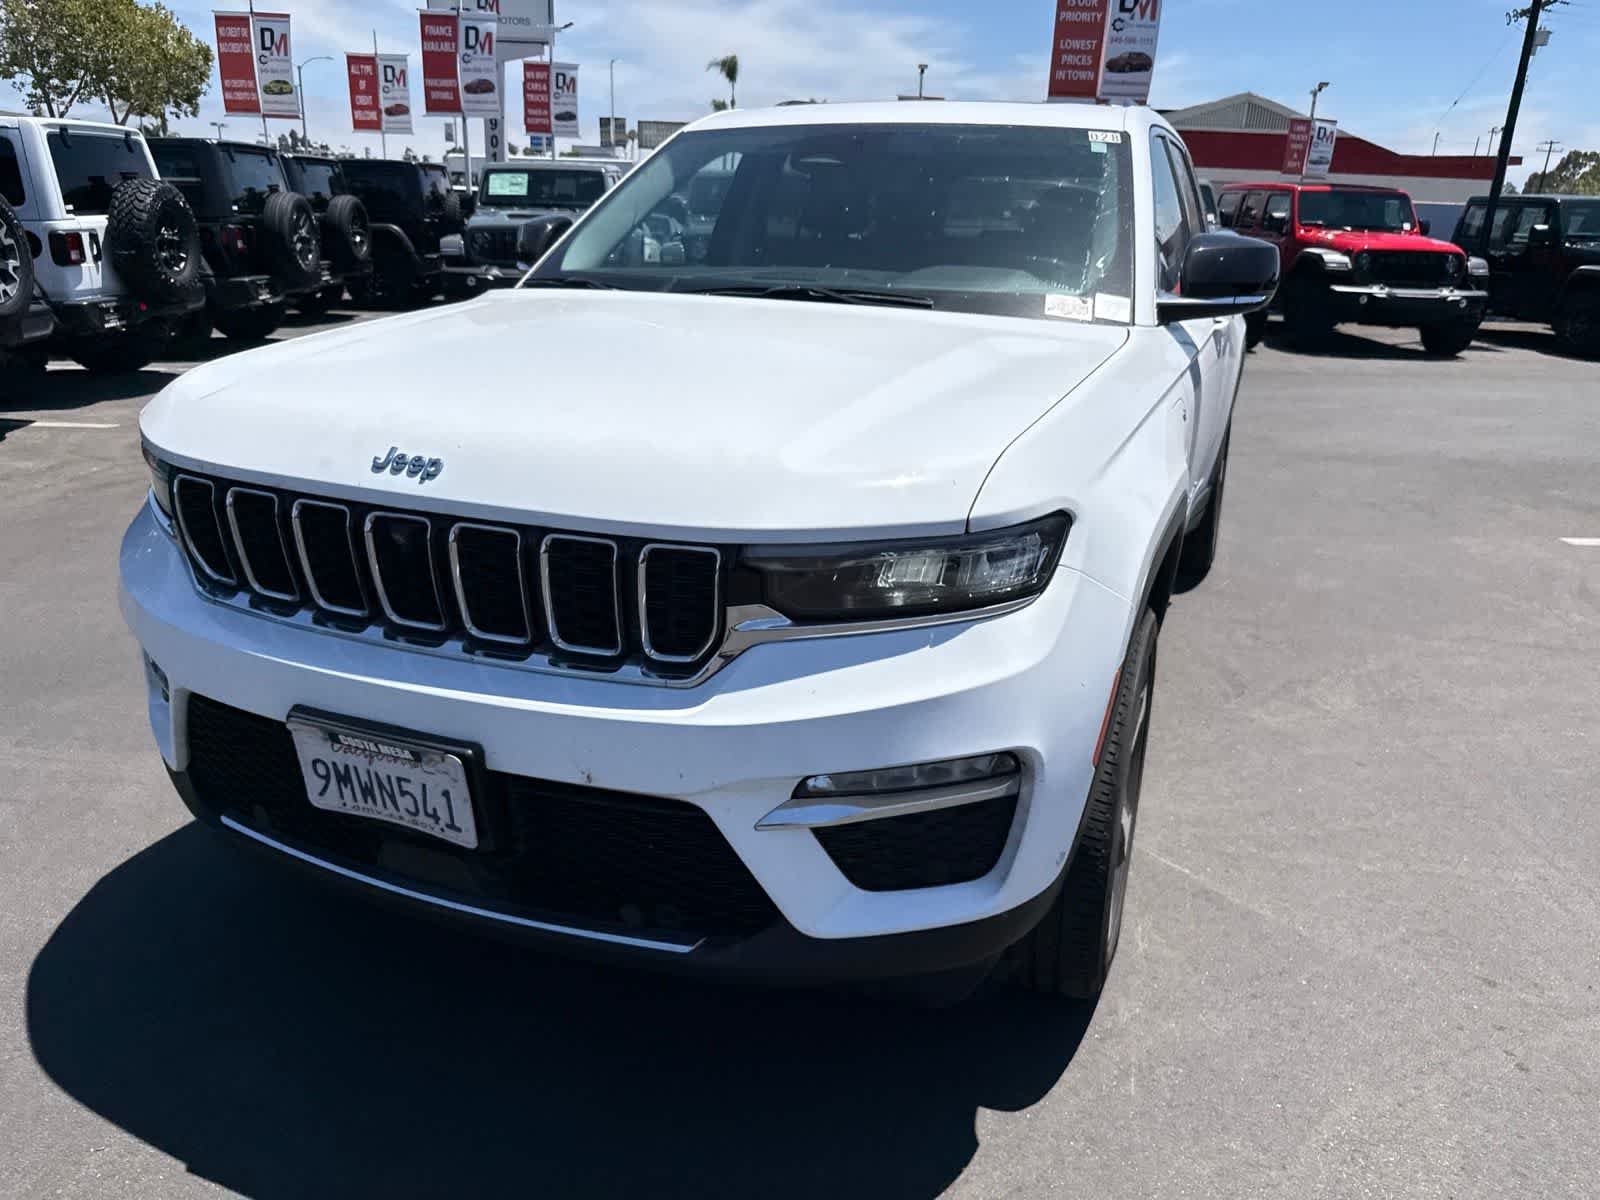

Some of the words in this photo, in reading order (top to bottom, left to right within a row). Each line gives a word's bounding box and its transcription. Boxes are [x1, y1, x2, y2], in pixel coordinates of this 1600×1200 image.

[497, 16, 531, 25] OTORS
[1060, 12, 1102, 22] PRIORITY
[425, 25, 452, 36] FINANCE
[260, 27, 288, 56] DM
[465, 26, 493, 55] DM
[1060, 40, 1097, 50] LOWEST
[424, 41, 456, 52] AVAILABLE
[1061, 55, 1093, 65] PRICES
[384, 65, 406, 87] DM
[1056, 70, 1065, 80] IN
[1066, 71, 1095, 81] TOWN
[556, 72, 576, 93] DM
[371, 446, 444, 484] Jeep
[312, 758, 462, 833] 9MWN541
